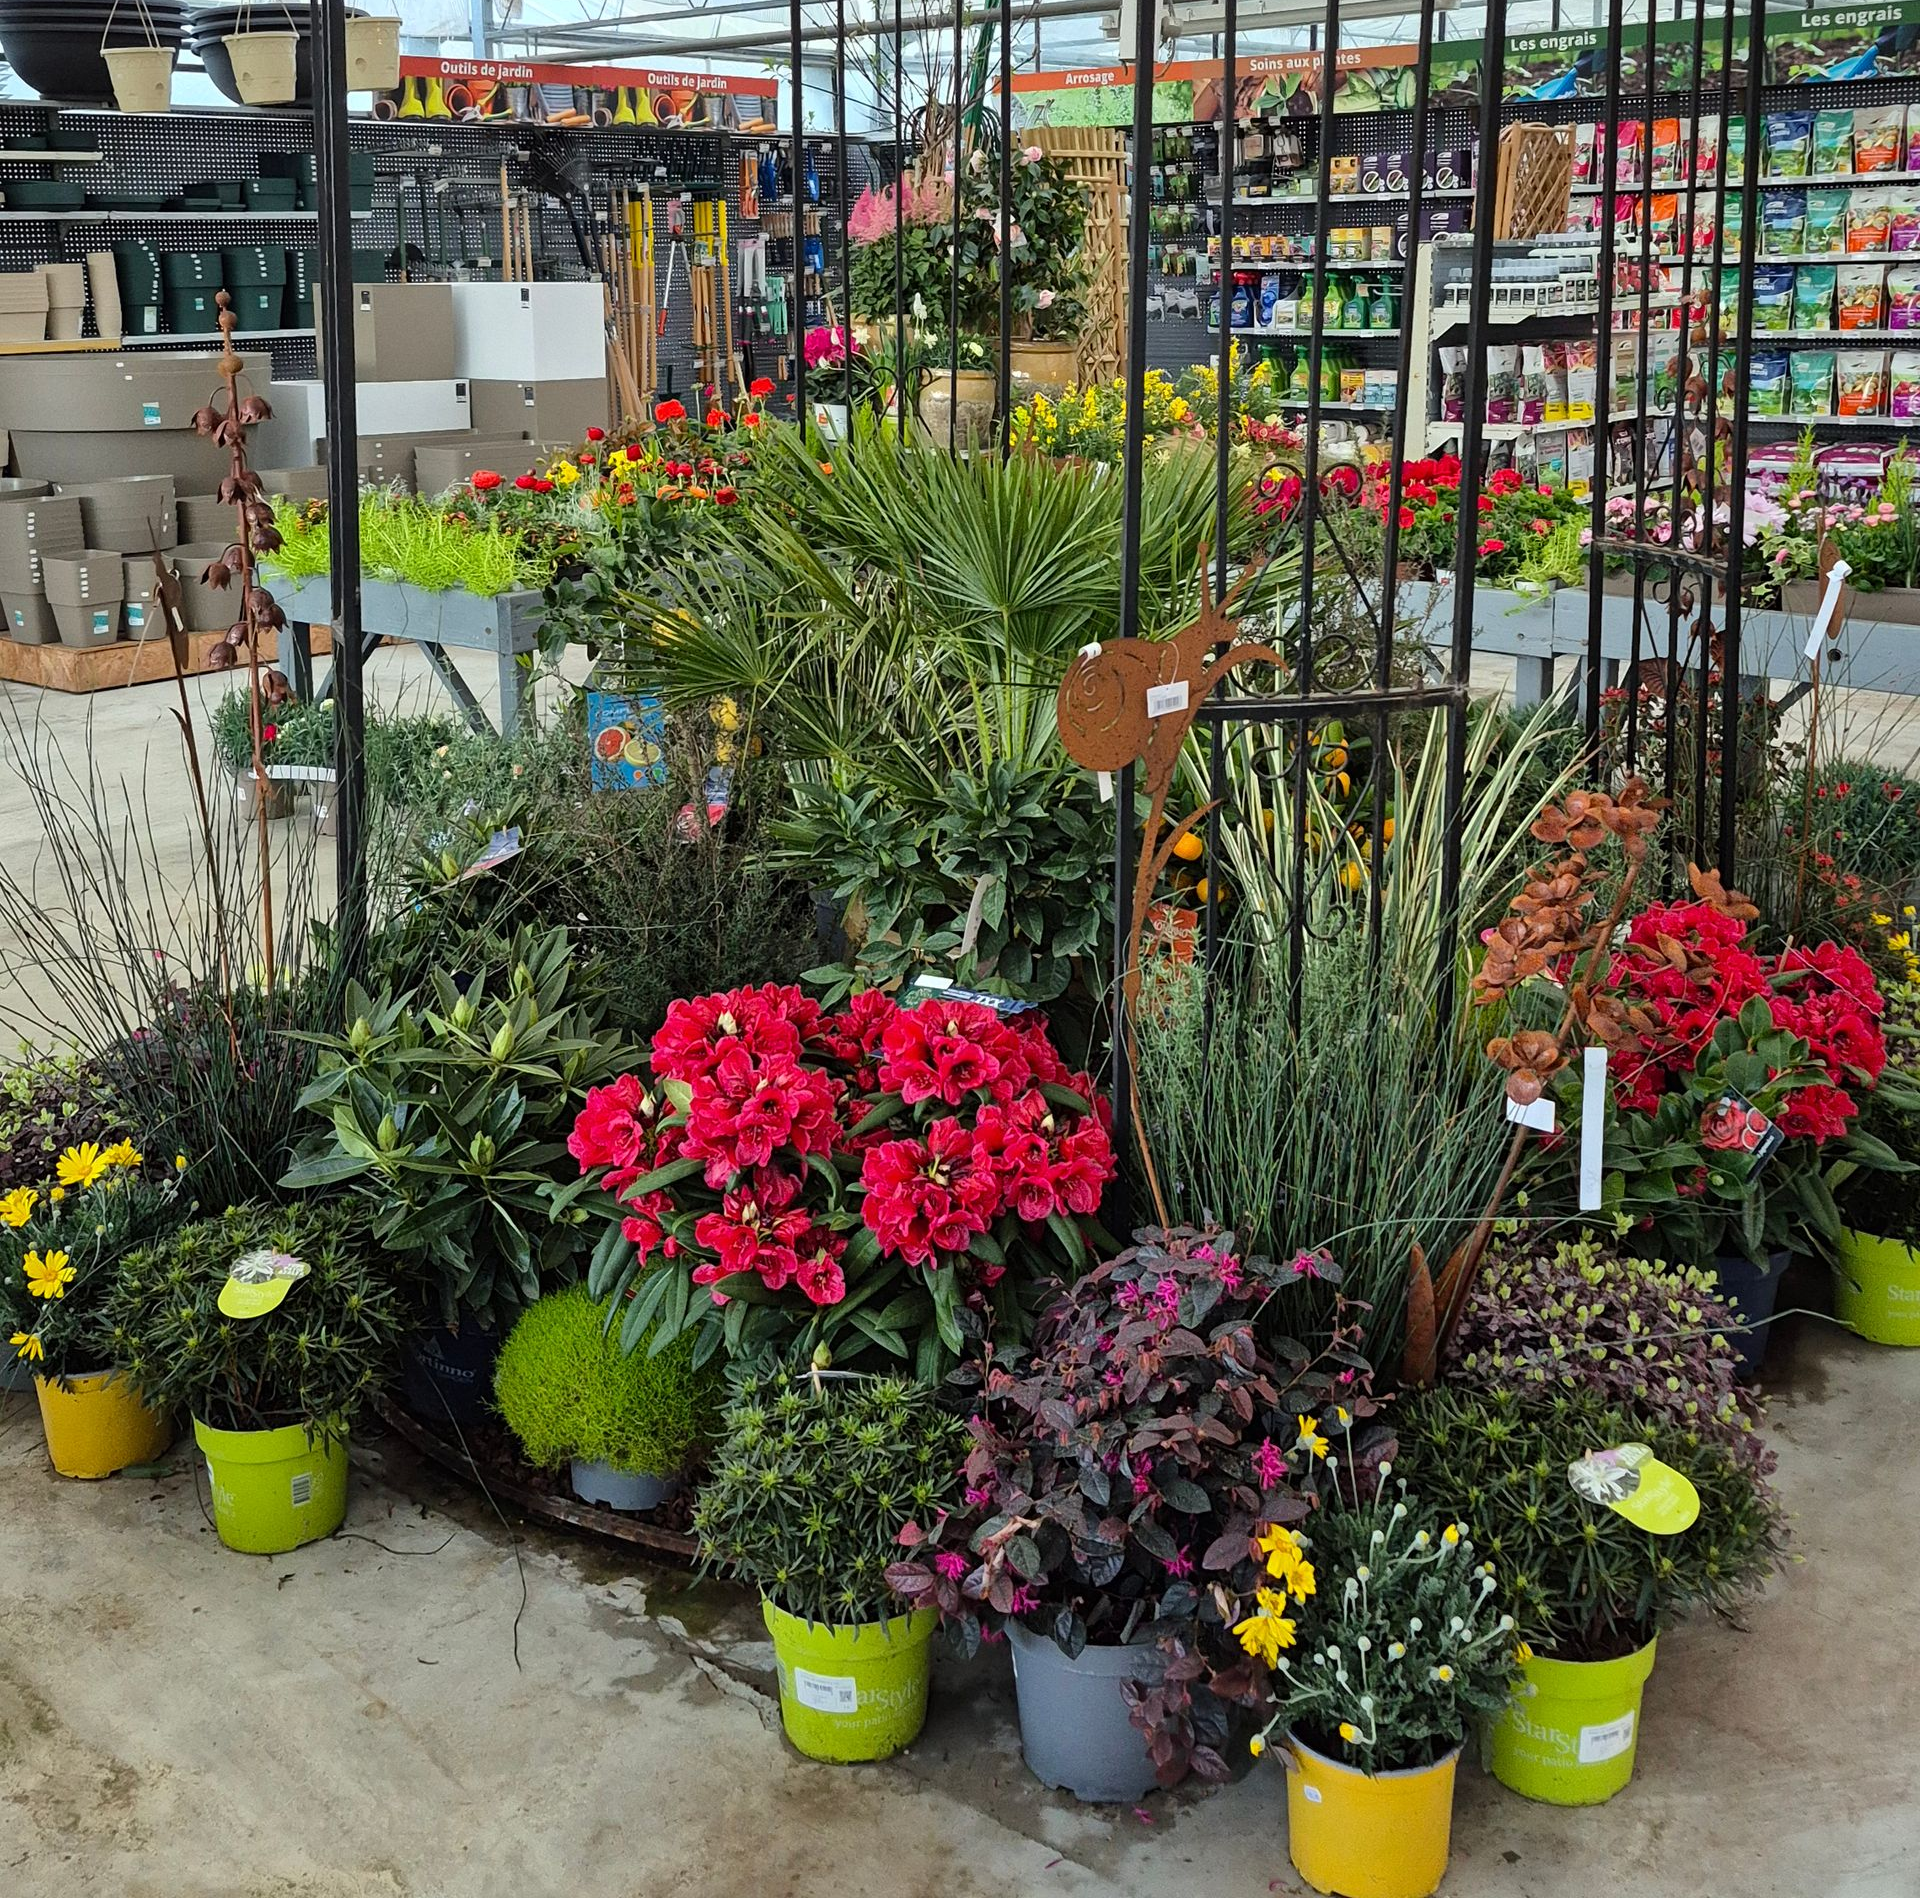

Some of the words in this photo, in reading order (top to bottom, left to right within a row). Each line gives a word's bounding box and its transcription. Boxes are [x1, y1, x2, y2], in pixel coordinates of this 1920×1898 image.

[1801, 13, 1831, 27] Les
[1834, 4, 1903, 27] engrais
[1510, 38, 1536, 52] Les
[1539, 31, 1597, 51] engrais
[440, 61, 478, 76] Outils
[480, 63, 496, 77] de
[497, 64, 533, 80] jardin
[1250, 58, 1284, 71] Soins
[1286, 56, 1311, 68] aux
[1313, 53, 1361, 70] plntes
[648, 72, 680, 86] Outils
[682, 75, 695, 87] de
[696, 75, 727, 91] jardin
[1065, 72, 1115, 85] Arrosage
